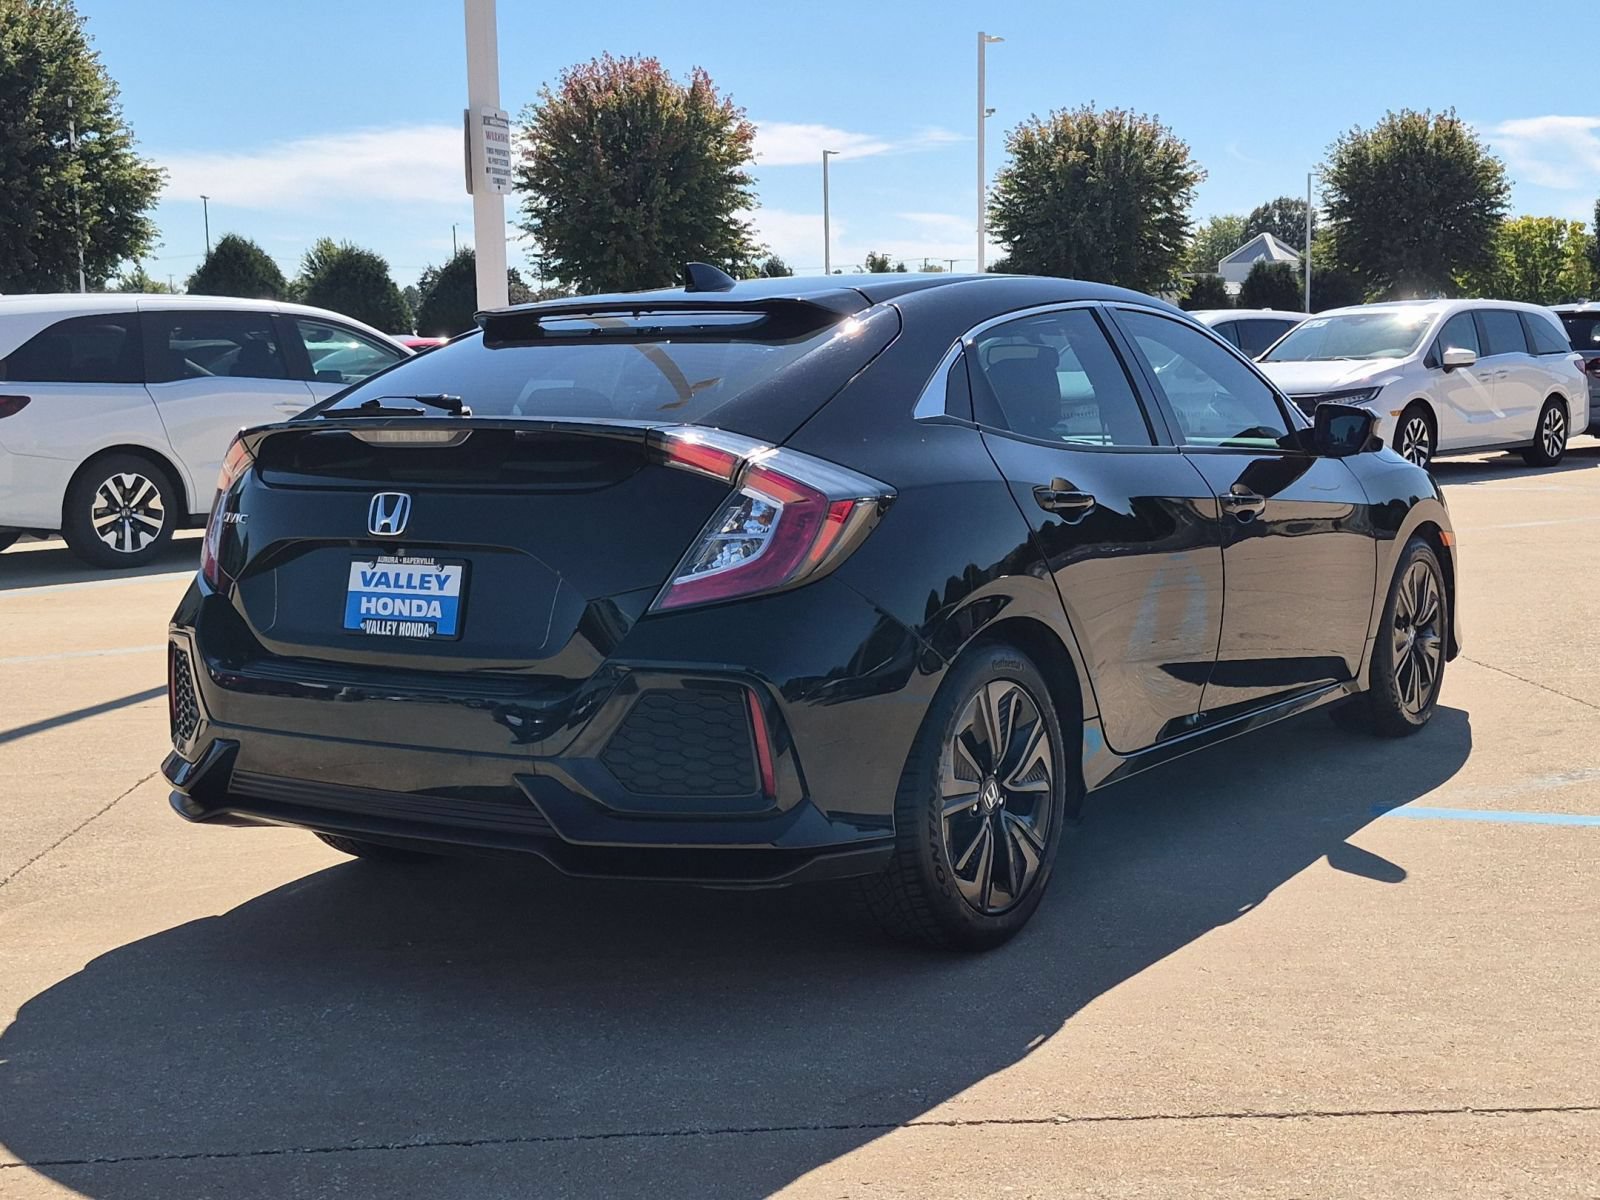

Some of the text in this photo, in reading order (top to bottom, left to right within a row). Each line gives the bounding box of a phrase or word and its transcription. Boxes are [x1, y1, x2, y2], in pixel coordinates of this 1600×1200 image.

[377, 555, 434, 565] AURORA NAPERVILLE
[360, 570, 452, 591] VALLEY
[360, 596, 442, 619] HONDA
[365, 619, 430, 638] VALLEY HONDA
